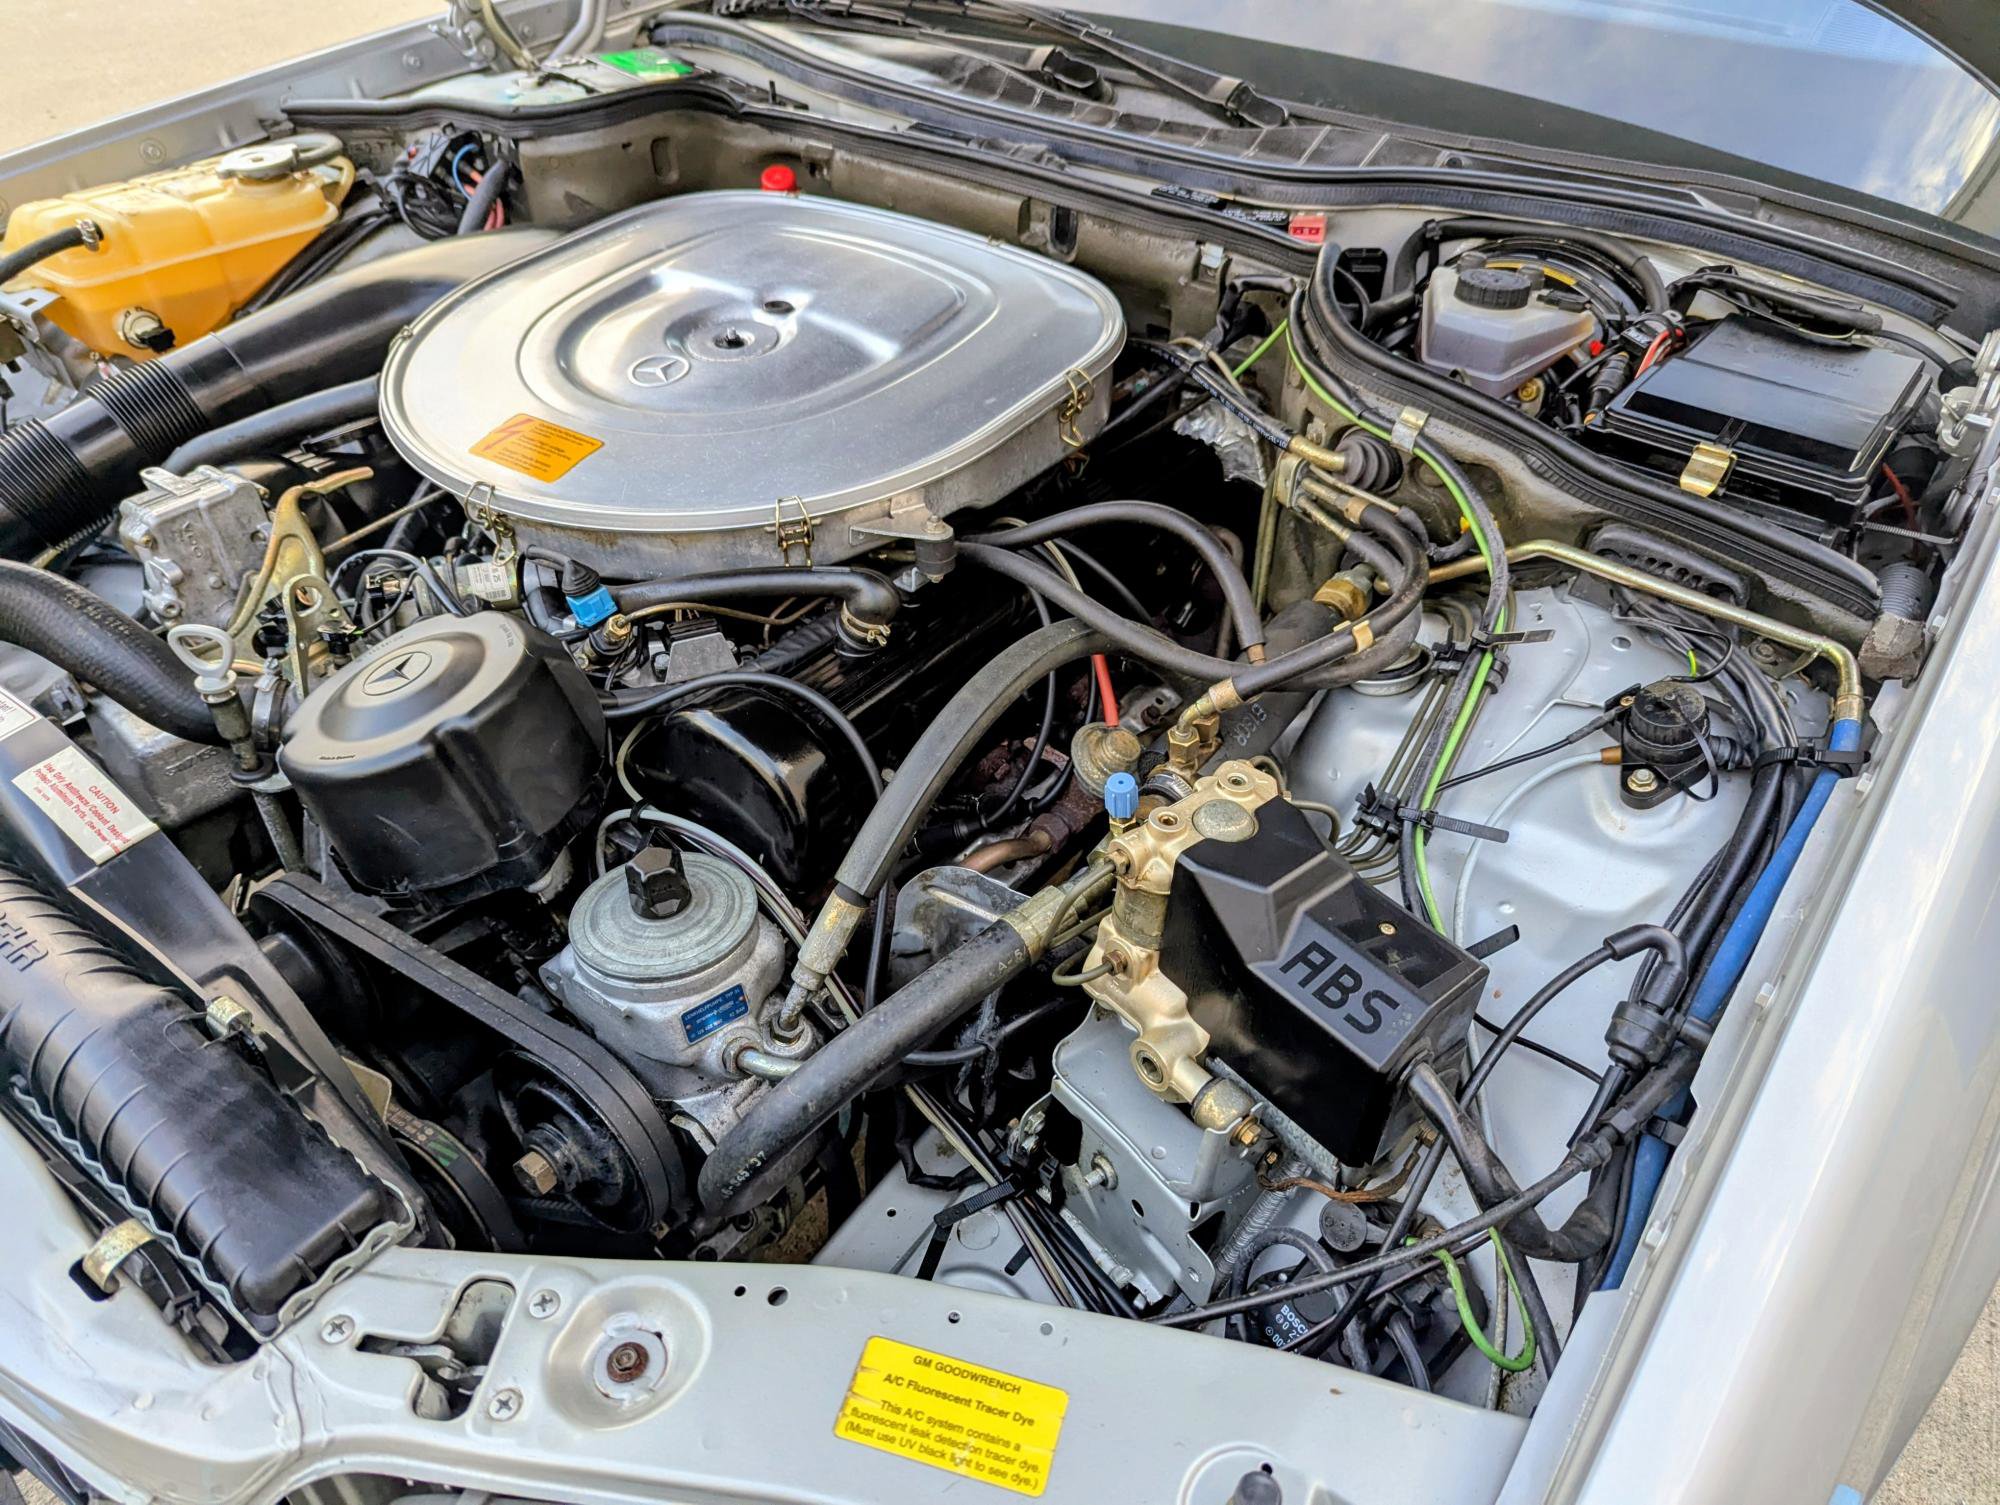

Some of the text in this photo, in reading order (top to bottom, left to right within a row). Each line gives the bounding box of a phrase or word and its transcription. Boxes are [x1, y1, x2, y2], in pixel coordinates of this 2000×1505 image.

[43, 761, 55, 774] Use
[89, 785, 120, 815] CAUTION
[1279, 941, 1400, 1034] ABS
[1272, 1334, 1287, 1347] 00
[883, 1373, 1035, 1427] A/C Fluorescent Tracer Dye
[913, 1355, 1021, 1394] GM GOODWRENCH
[850, 1406, 908, 1432] fluorescent
[909, 1424, 931, 1439] leak
[985, 1449, 1016, 1465] tracer
[1018, 1458, 1041, 1474] dye.
[880, 1399, 1021, 1452] This A/C system contains a
[844, 1421, 875, 1438] (Must
[876, 1432, 897, 1444] use
[899, 1436, 917, 1449] UV
[918, 1442, 946, 1460] black
[974, 1461, 985, 1472] to
[988, 1466, 1008, 1479] see
[1010, 1472, 1039, 1490] dye.)
